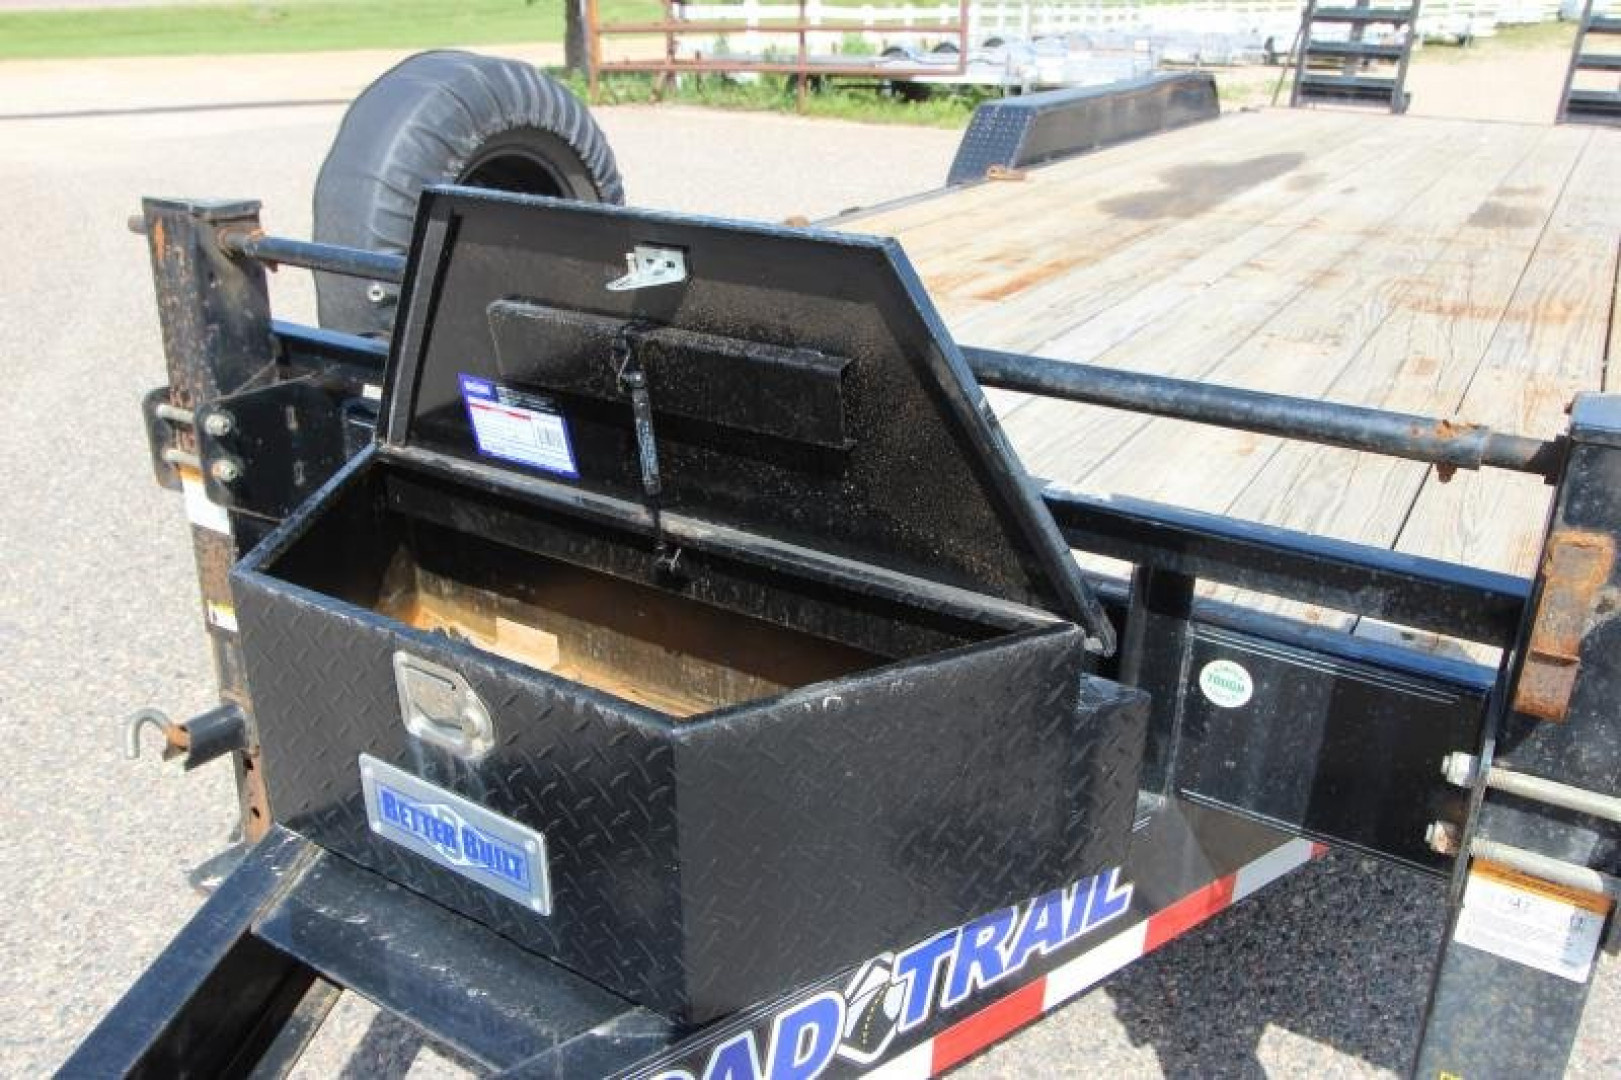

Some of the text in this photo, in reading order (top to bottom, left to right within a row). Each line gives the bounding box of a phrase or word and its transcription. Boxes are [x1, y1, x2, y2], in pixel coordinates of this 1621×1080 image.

[381, 789, 524, 881] BETTER BUILT
[650, 866, 1135, 1080] AD TRAIL
